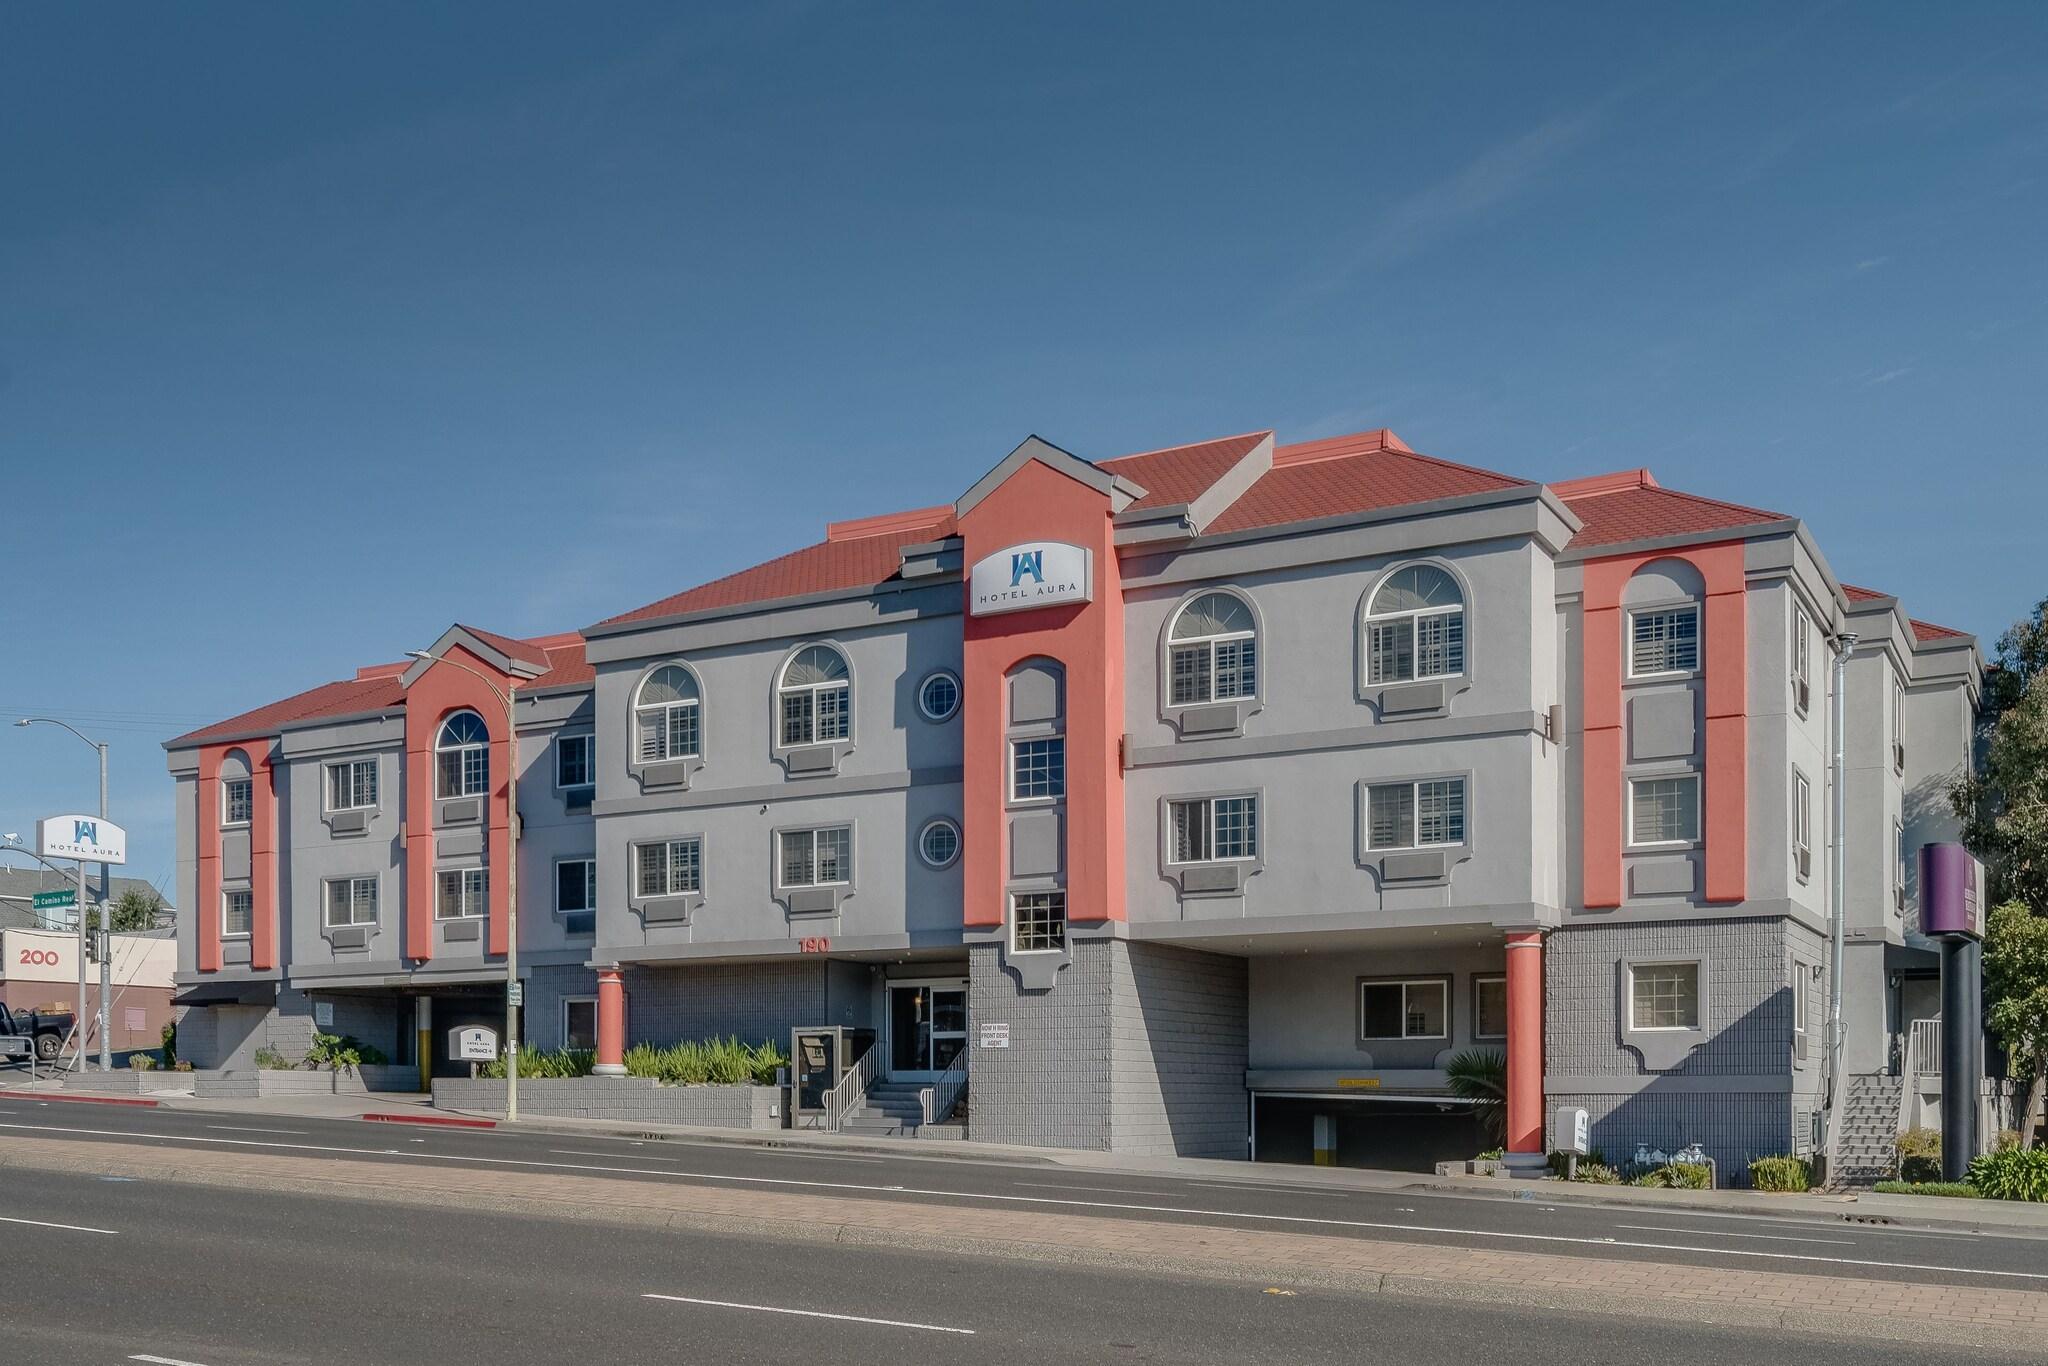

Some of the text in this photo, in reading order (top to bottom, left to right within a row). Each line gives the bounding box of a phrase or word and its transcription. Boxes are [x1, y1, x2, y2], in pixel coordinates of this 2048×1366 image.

[980, 583, 1077, 604] HOTEL AURA
[50, 844, 120, 857] HOTEL AURA
[34, 894, 75, 906] El Camino Real
[799, 936, 832, 953] 190
[20, 949, 59, 966] 200
